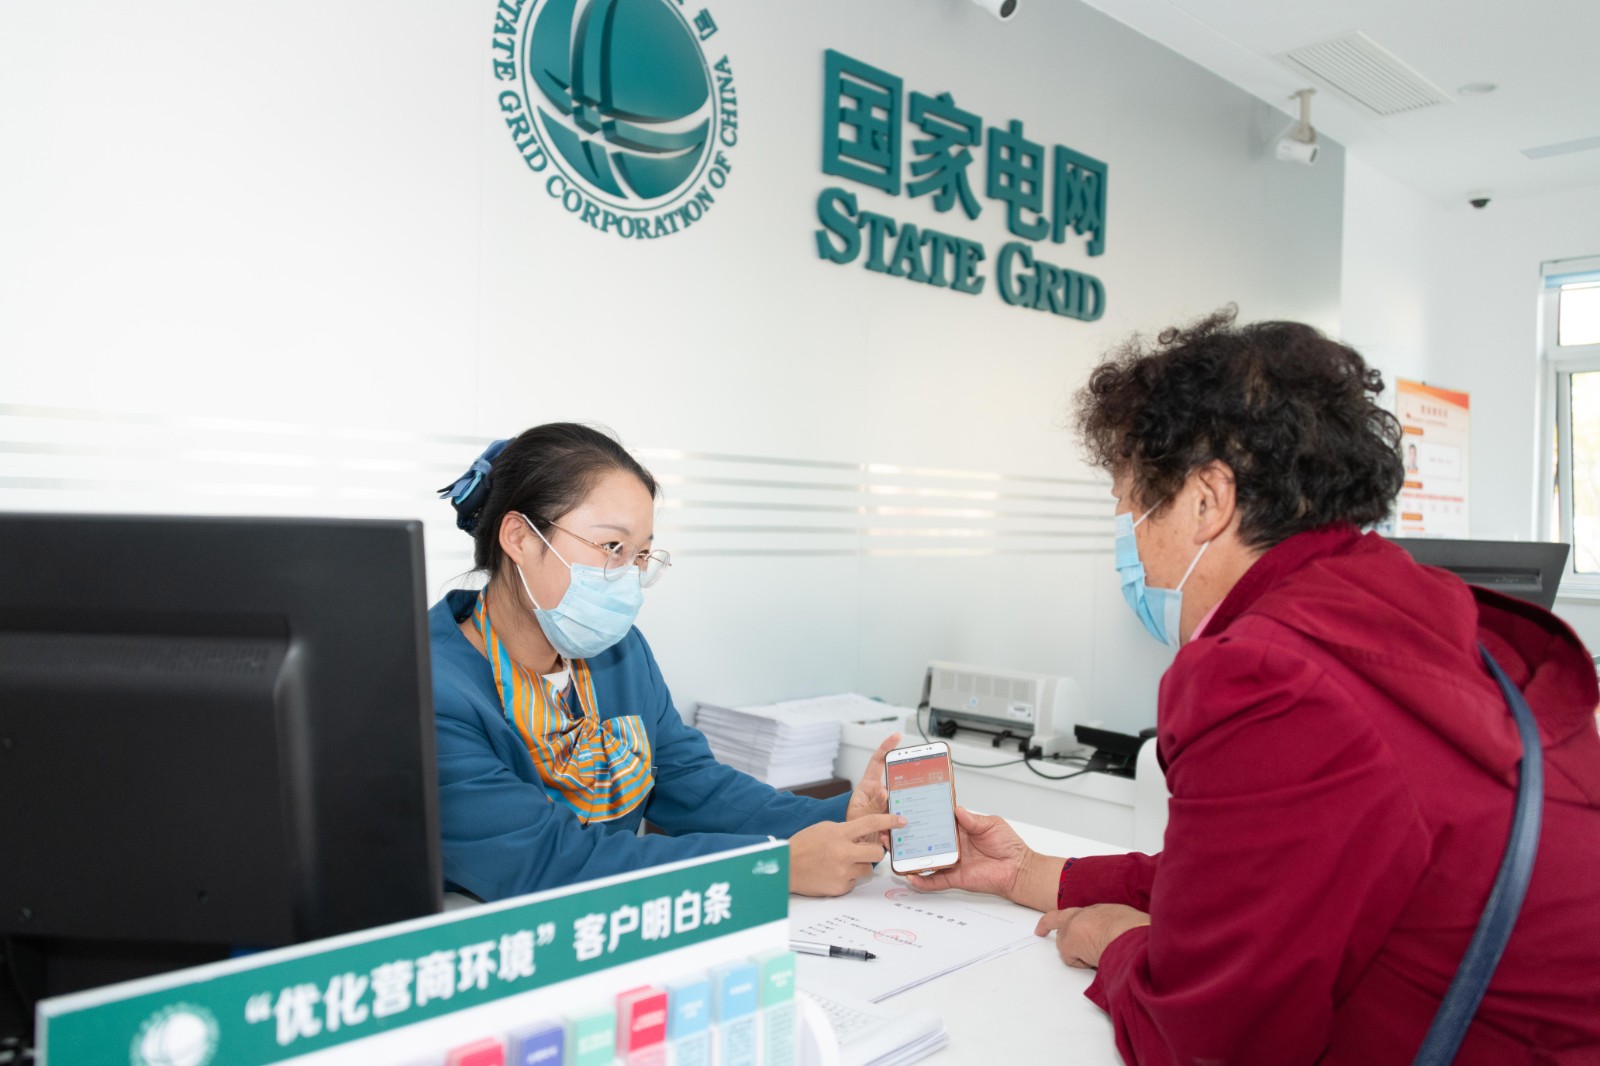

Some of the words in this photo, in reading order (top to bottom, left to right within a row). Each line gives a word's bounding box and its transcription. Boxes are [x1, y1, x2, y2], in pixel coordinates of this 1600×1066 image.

[498, 90, 549, 173] GRID
[714, 54, 738, 147] CHINA
[708, 150, 732, 189] OF
[822, 48, 1108, 257] 国家电网
[545, 174, 716, 240] CORPORATION
[815, 187, 986, 295] STATE
[997, 241, 1106, 322] GRID
[572, 882, 733, 962] 客户明白条
